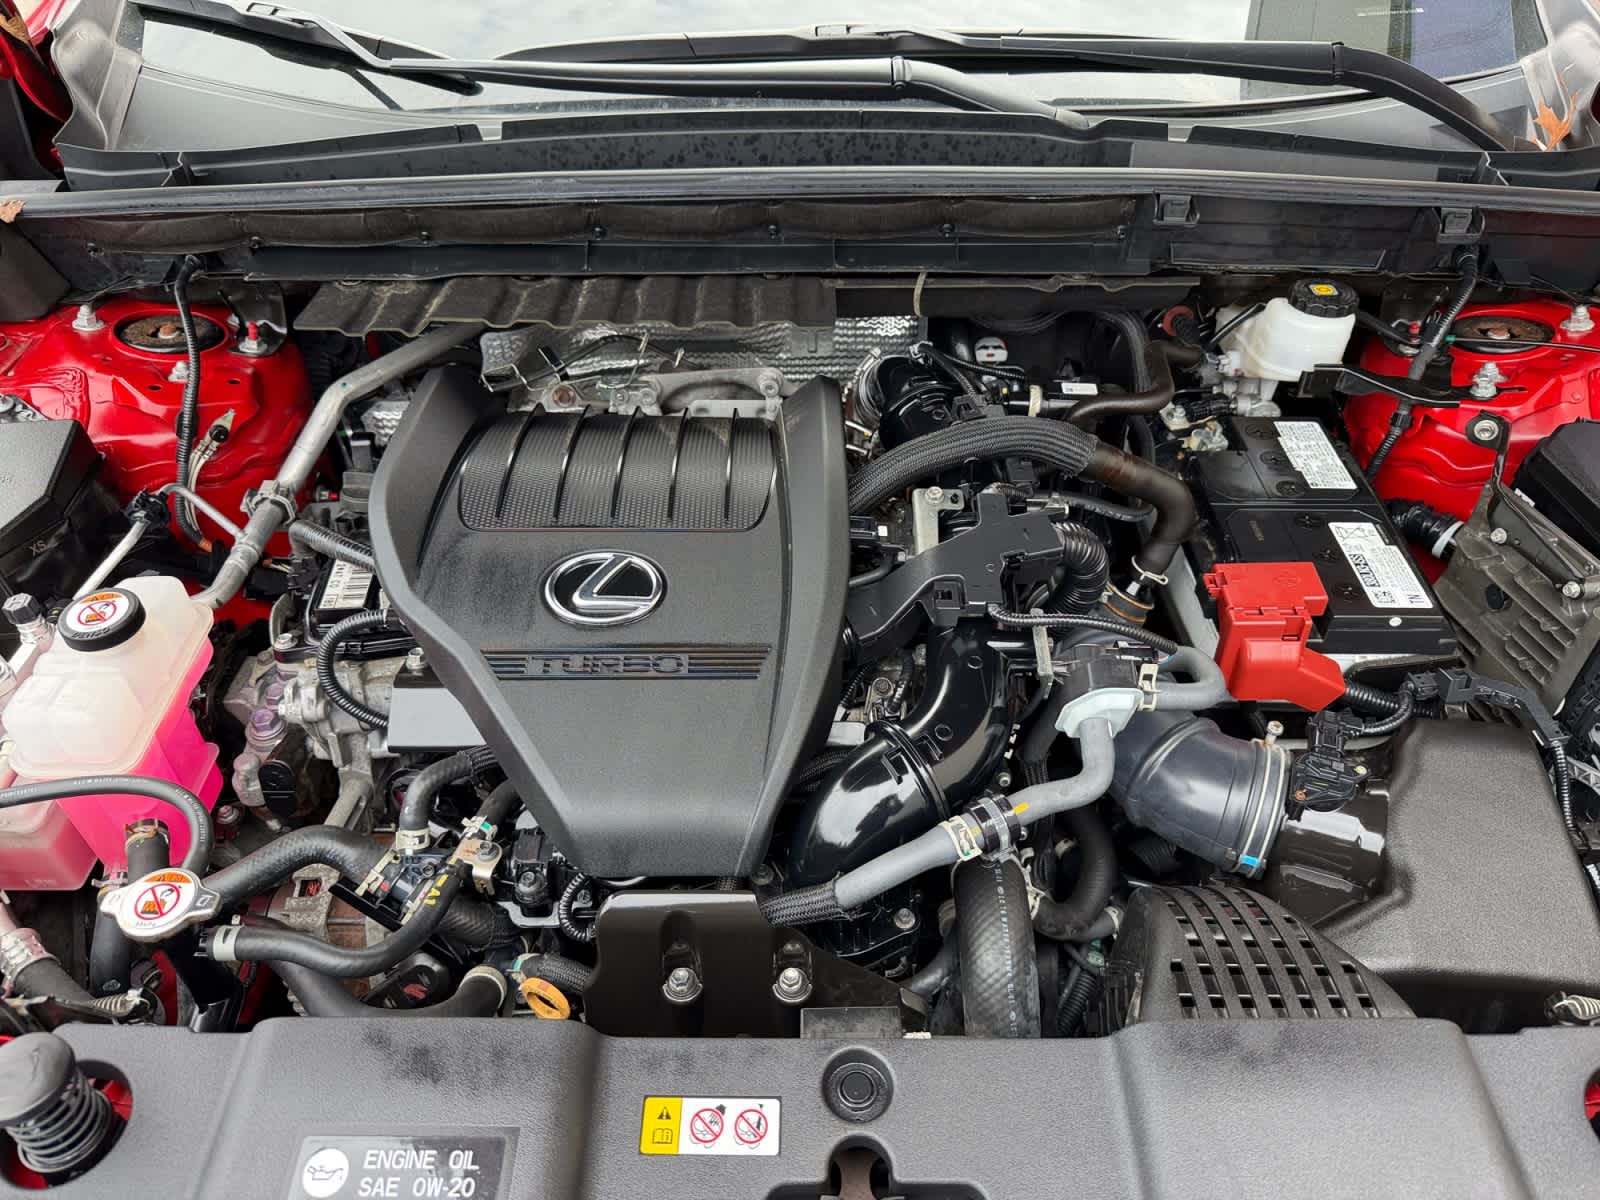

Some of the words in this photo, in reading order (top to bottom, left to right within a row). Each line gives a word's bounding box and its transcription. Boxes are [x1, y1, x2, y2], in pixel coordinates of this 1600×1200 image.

[530, 655, 686, 675] TURBO
[363, 1149, 437, 1170] ENGINE
[448, 1149, 480, 1170] OIL
[357, 1176, 400, 1197] SAE
[412, 1176, 476, 1198] 0W-20
